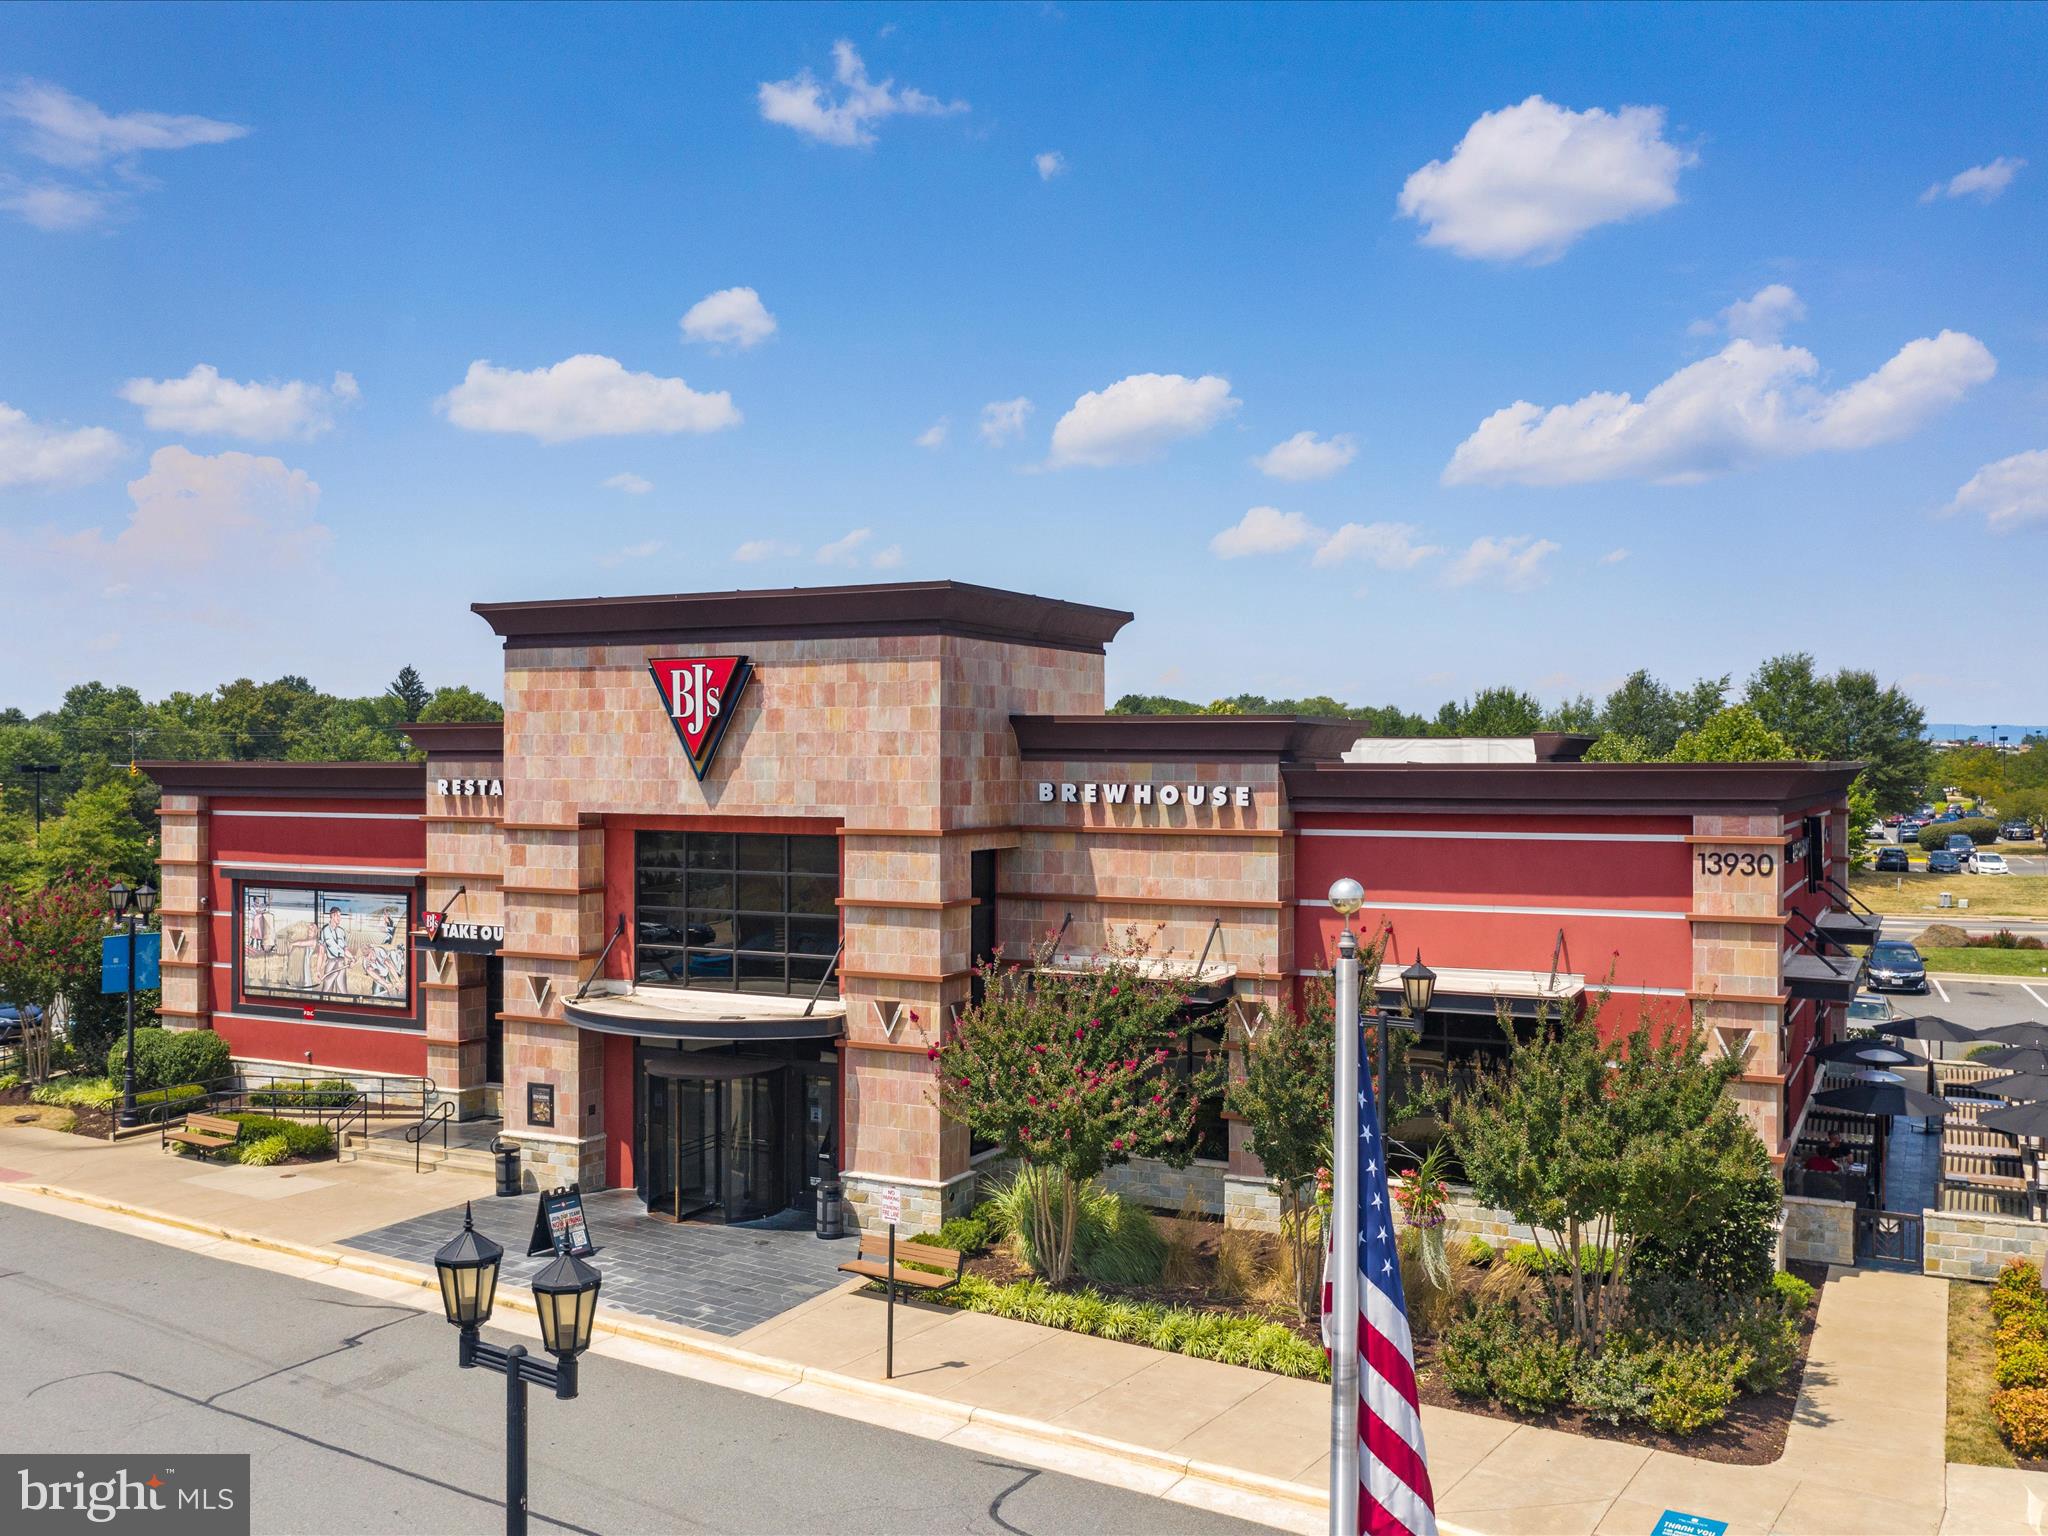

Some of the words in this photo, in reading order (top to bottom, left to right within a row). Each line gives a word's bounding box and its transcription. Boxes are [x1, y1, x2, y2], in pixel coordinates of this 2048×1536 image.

[670, 664, 720, 734] BJ's
[437, 779, 503, 796] RESTA
[1038, 782, 1251, 807] BREWHOUSE
[1697, 852, 1774, 877] 13930
[426, 914, 439, 932] BJ's
[441, 923, 478, 940] TAKE
[480, 926, 504, 941] OU
